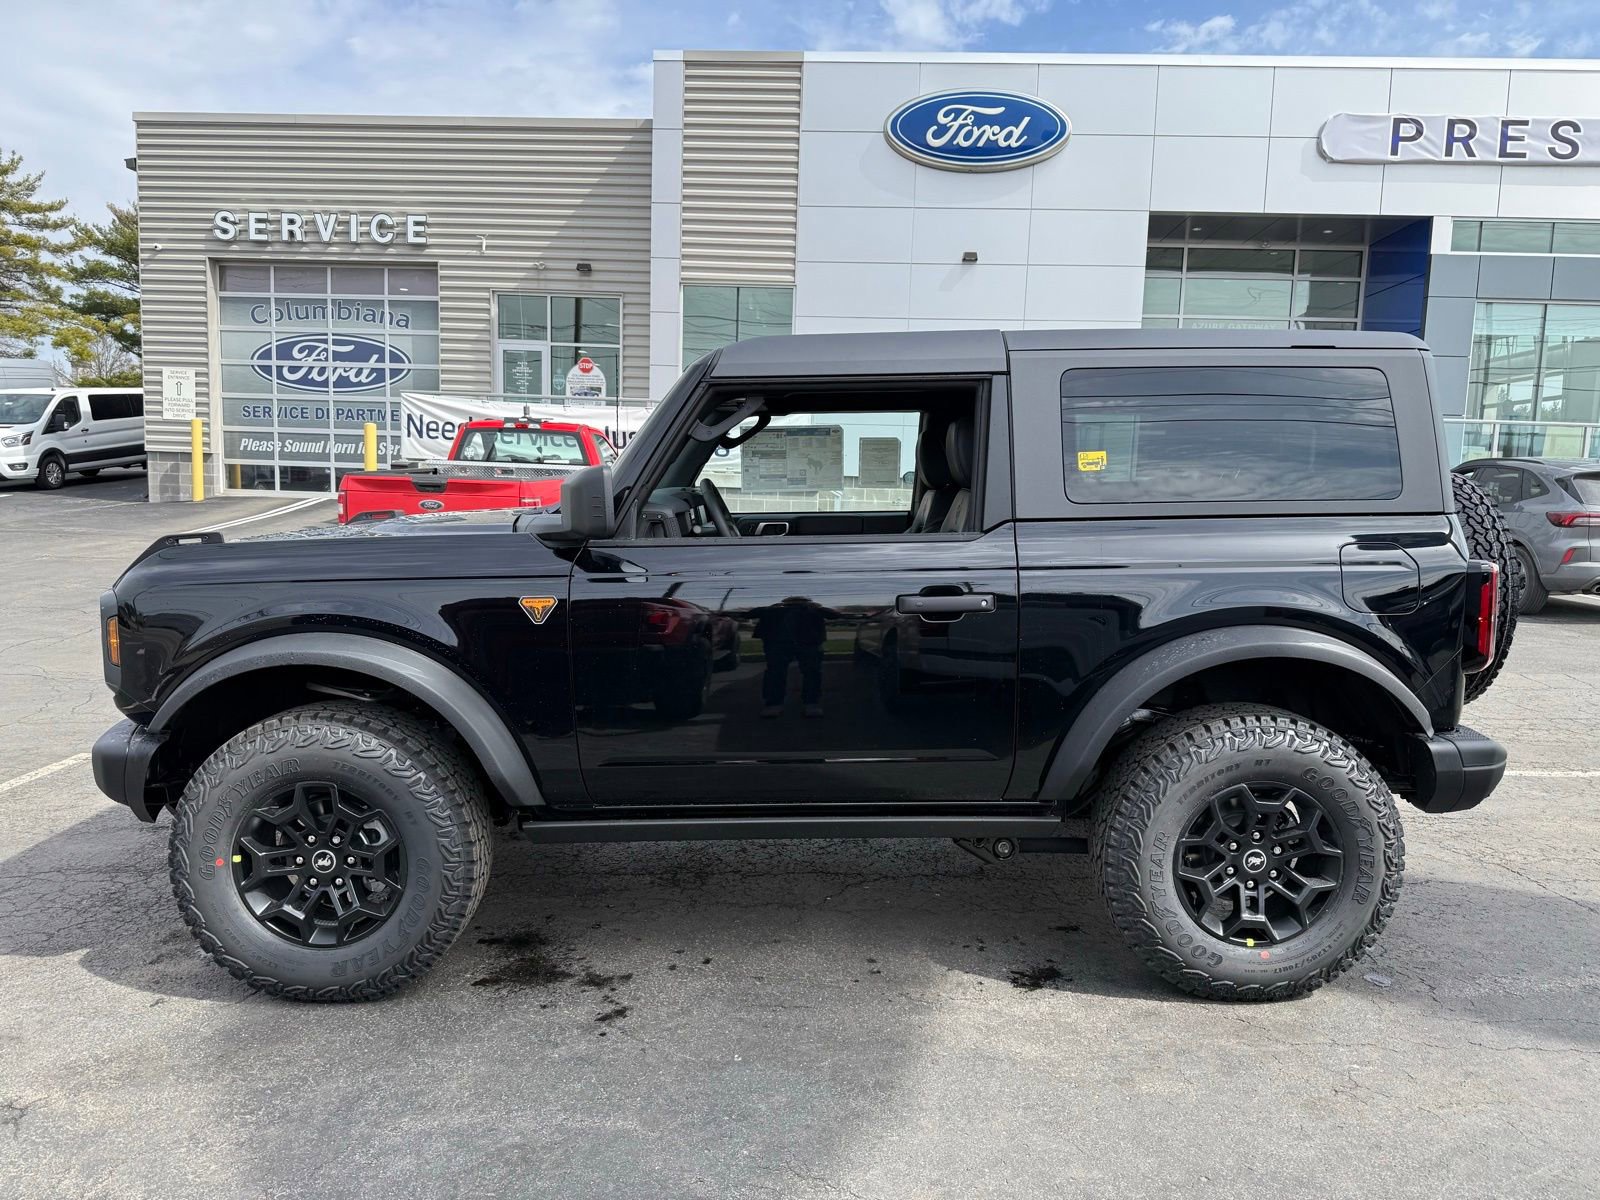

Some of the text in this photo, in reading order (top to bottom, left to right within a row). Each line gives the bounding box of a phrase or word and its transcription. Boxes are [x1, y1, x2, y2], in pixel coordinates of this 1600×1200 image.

[926, 104, 1031, 148] Ford
[1389, 117, 1582, 160] PRES
[213, 209, 428, 244] SERVICE
[250, 301, 411, 329] Columbiana
[282, 341, 380, 384] Ford
[240, 438, 282, 452] Please
[284, 439, 325, 453] Sound
